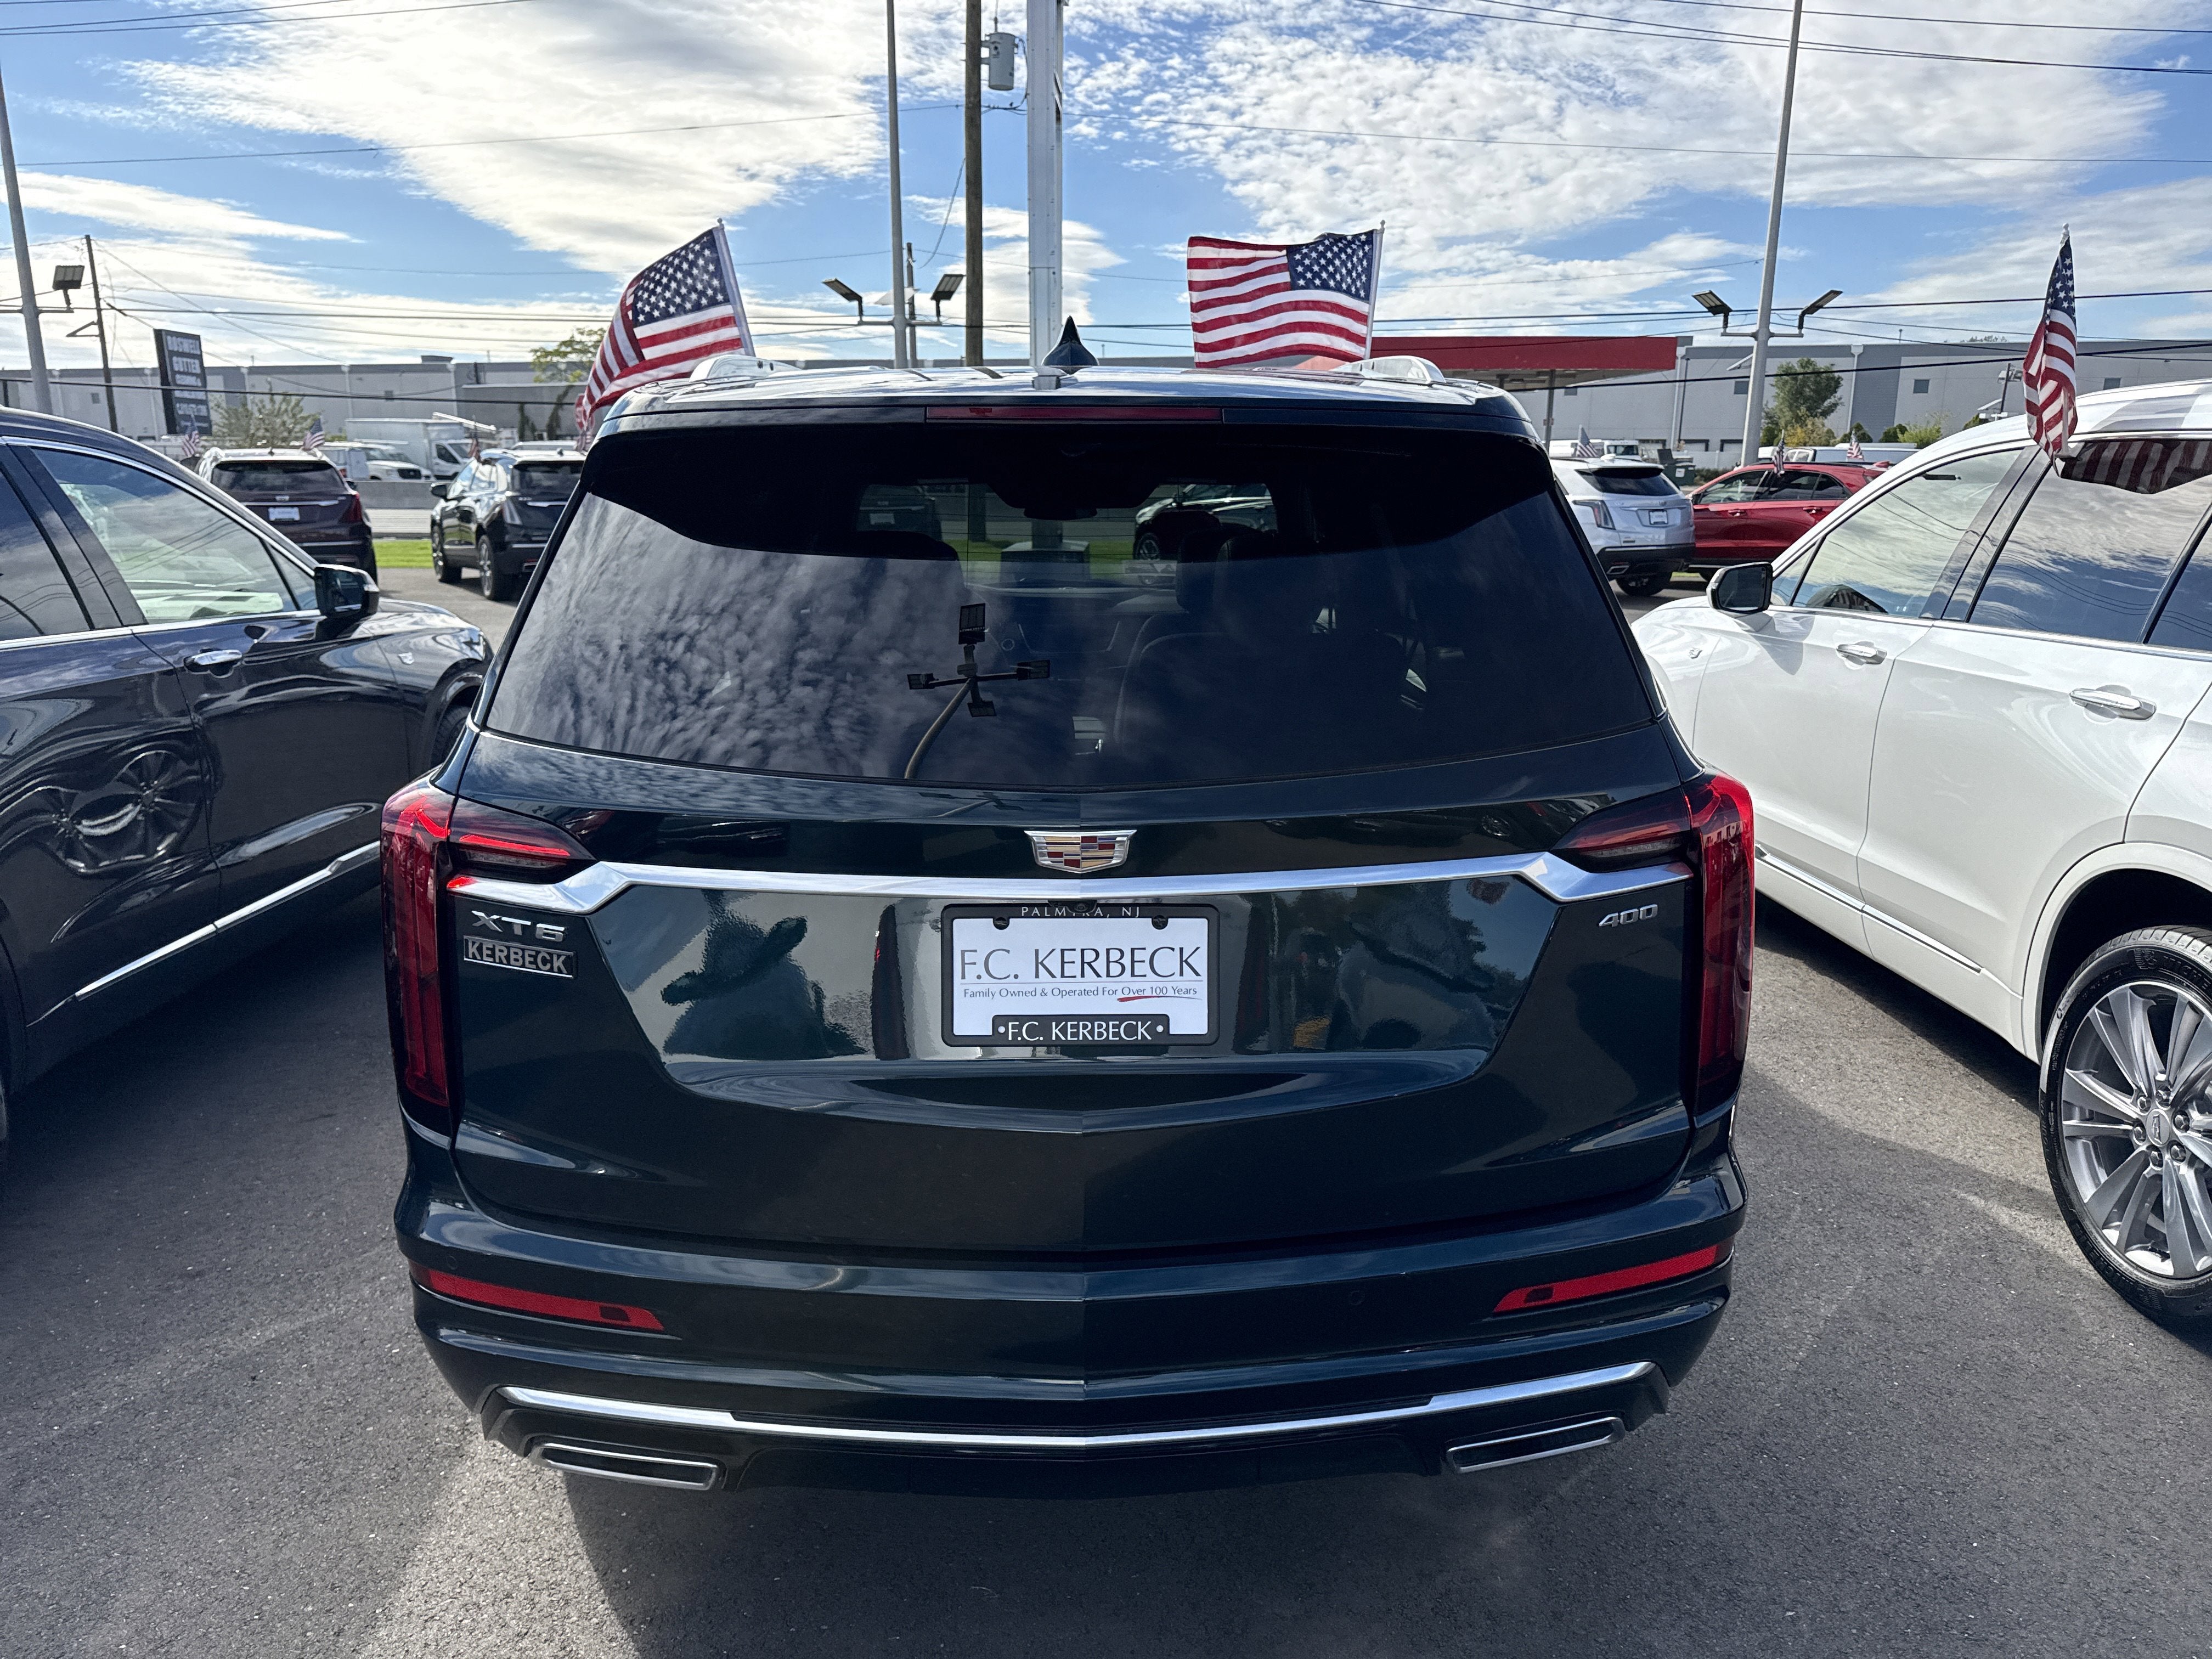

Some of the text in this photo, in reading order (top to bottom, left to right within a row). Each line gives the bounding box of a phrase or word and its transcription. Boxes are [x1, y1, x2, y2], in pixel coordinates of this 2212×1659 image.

[1022, 907, 1140, 918] PALMA, NJ
[1598, 904, 1658, 927] 400
[471, 910, 566, 942] XT6
[468, 939, 568, 974] KERBECK
[961, 946, 1201, 980] F.C. KERBECK
[964, 986, 1197, 1000] Family Owned & Operated For Over 100 Years
[1008, 1020, 1152, 1041] F.C. KERBECK
